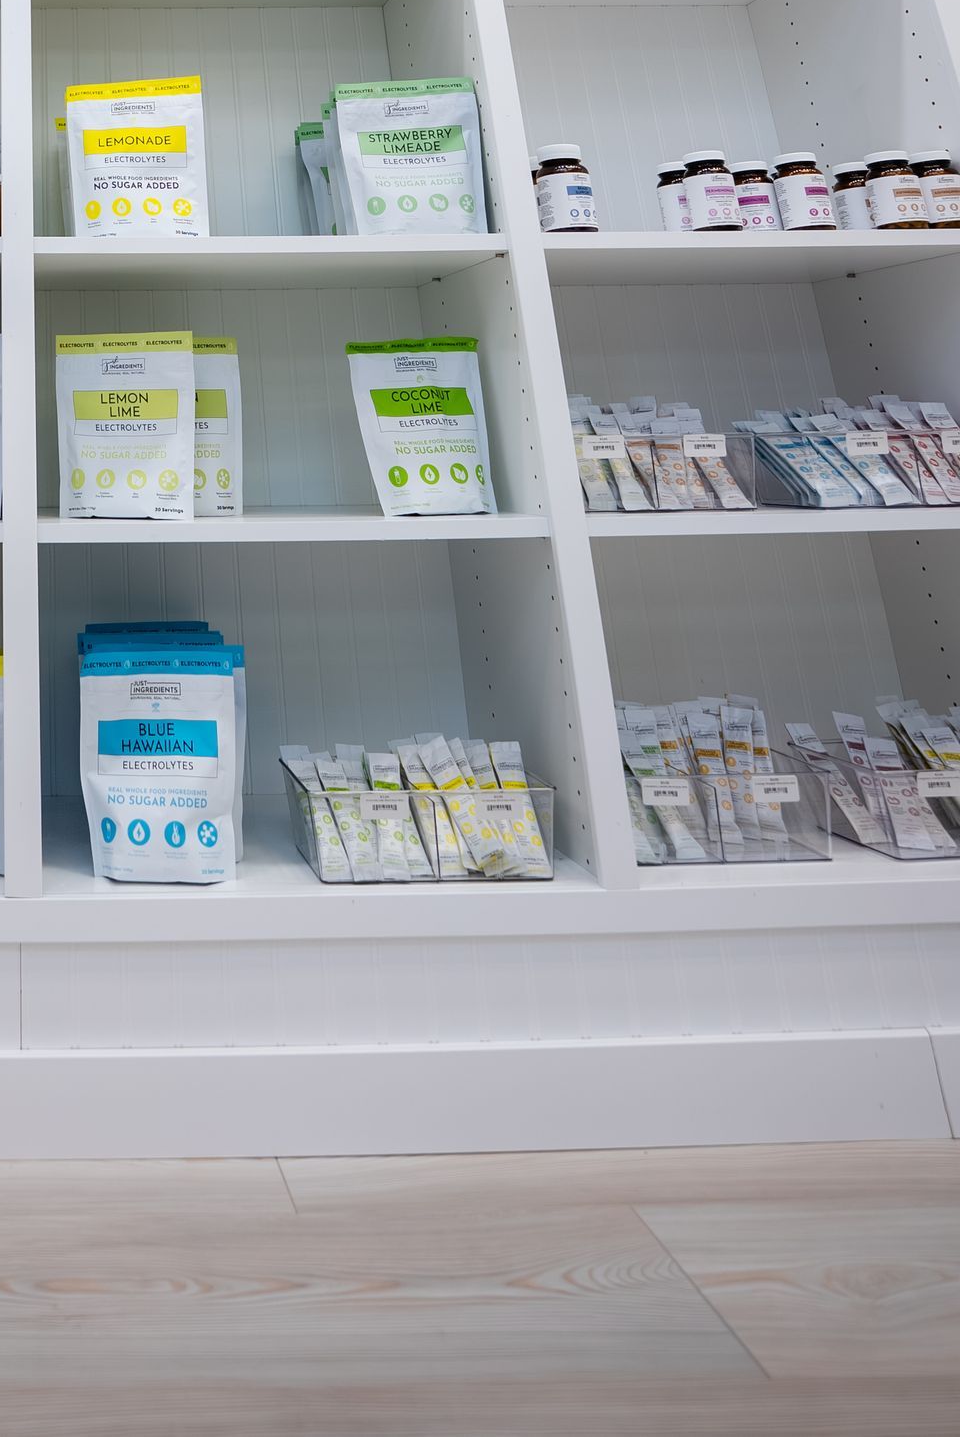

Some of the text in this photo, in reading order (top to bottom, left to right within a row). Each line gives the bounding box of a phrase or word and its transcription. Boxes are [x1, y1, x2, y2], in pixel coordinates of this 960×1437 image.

[369, 128, 452, 142] STRAWBERRY
[98, 136, 171, 148] LEMONADE
[383, 141, 442, 153] LIMEADE
[104, 156, 166, 164] ELECTROLYTES
[383, 156, 446, 164] ELECTROLYTES
[112, 181, 142, 189] SUGAR
[100, 393, 149, 404] LEMON
[391, 389, 450, 402] COCONUT
[109, 406, 141, 418] LIME
[411, 402, 443, 414] LIME
[95, 424, 157, 432] ELECTROLYTES
[396, 445, 477, 455] NO SUGAR ADDED
[138, 723, 175, 736] BLUE
[122, 739, 194, 754] HAWAIIAN
[123, 761, 194, 771] ELECTROLYTES
[168, 788, 208, 796] INGREDIENTS
[108, 794, 208, 808] NO SUGAR ADDED
